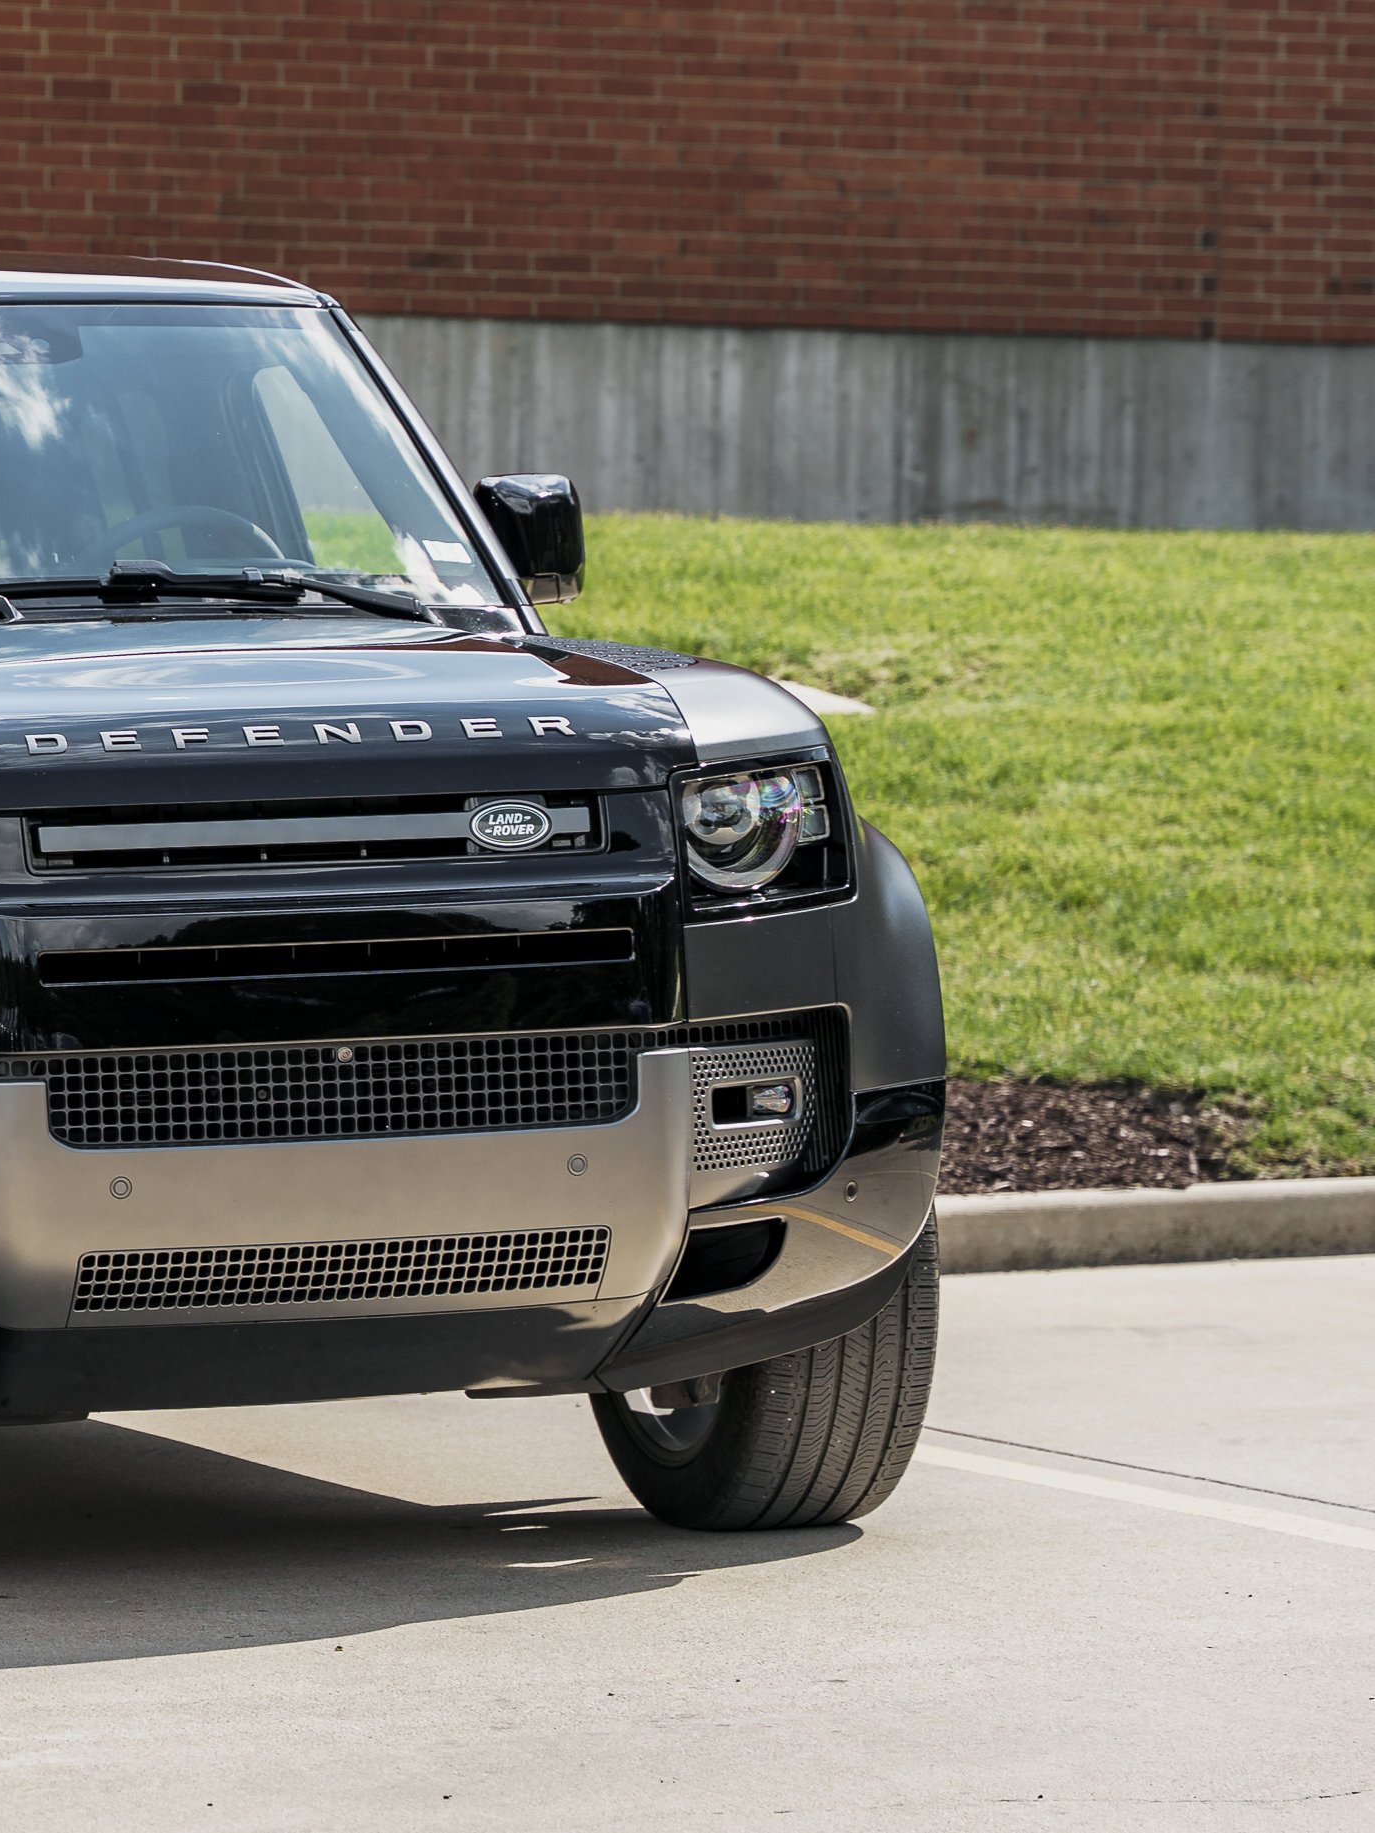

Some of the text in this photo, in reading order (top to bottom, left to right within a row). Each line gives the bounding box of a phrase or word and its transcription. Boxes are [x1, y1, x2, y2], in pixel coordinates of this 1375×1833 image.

[25, 715, 577, 756] DEFENDER
[488, 813, 523, 825] LAND
[492, 824, 535, 836] ROVER
